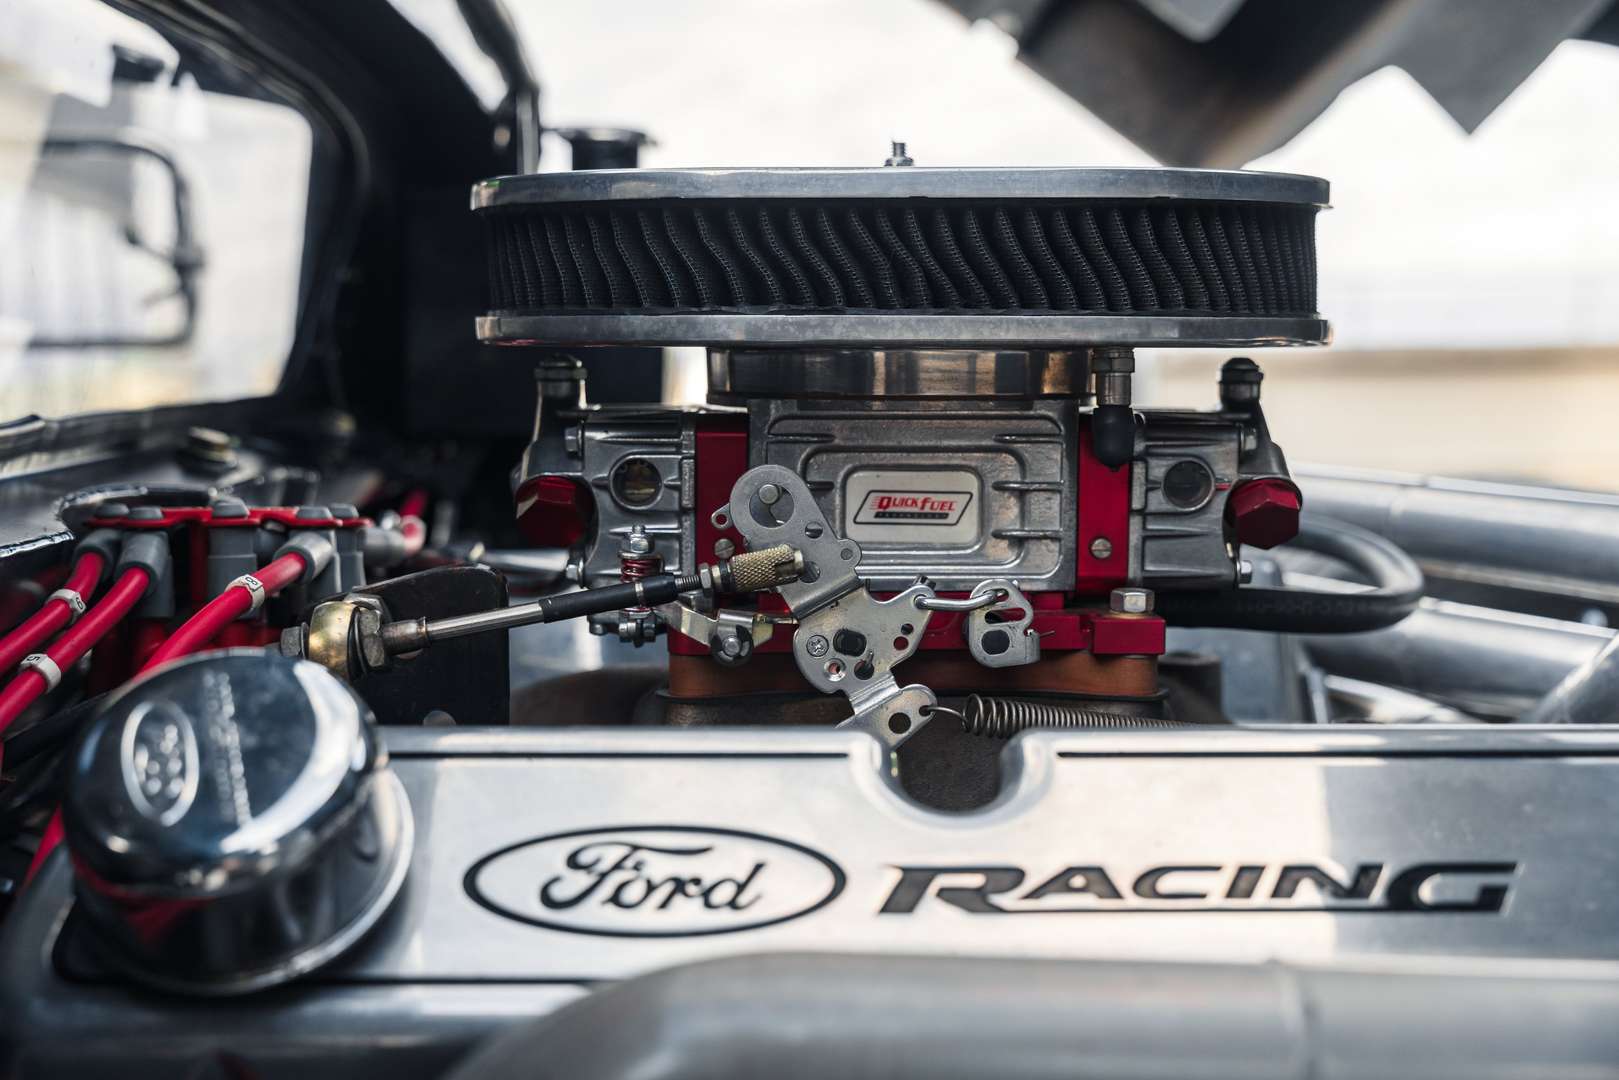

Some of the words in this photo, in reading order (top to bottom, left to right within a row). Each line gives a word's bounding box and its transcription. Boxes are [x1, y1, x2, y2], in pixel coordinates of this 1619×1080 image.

[878, 496, 918, 510] QUICK
[540, 841, 766, 911] Ford
[878, 862, 1520, 915] RACING
